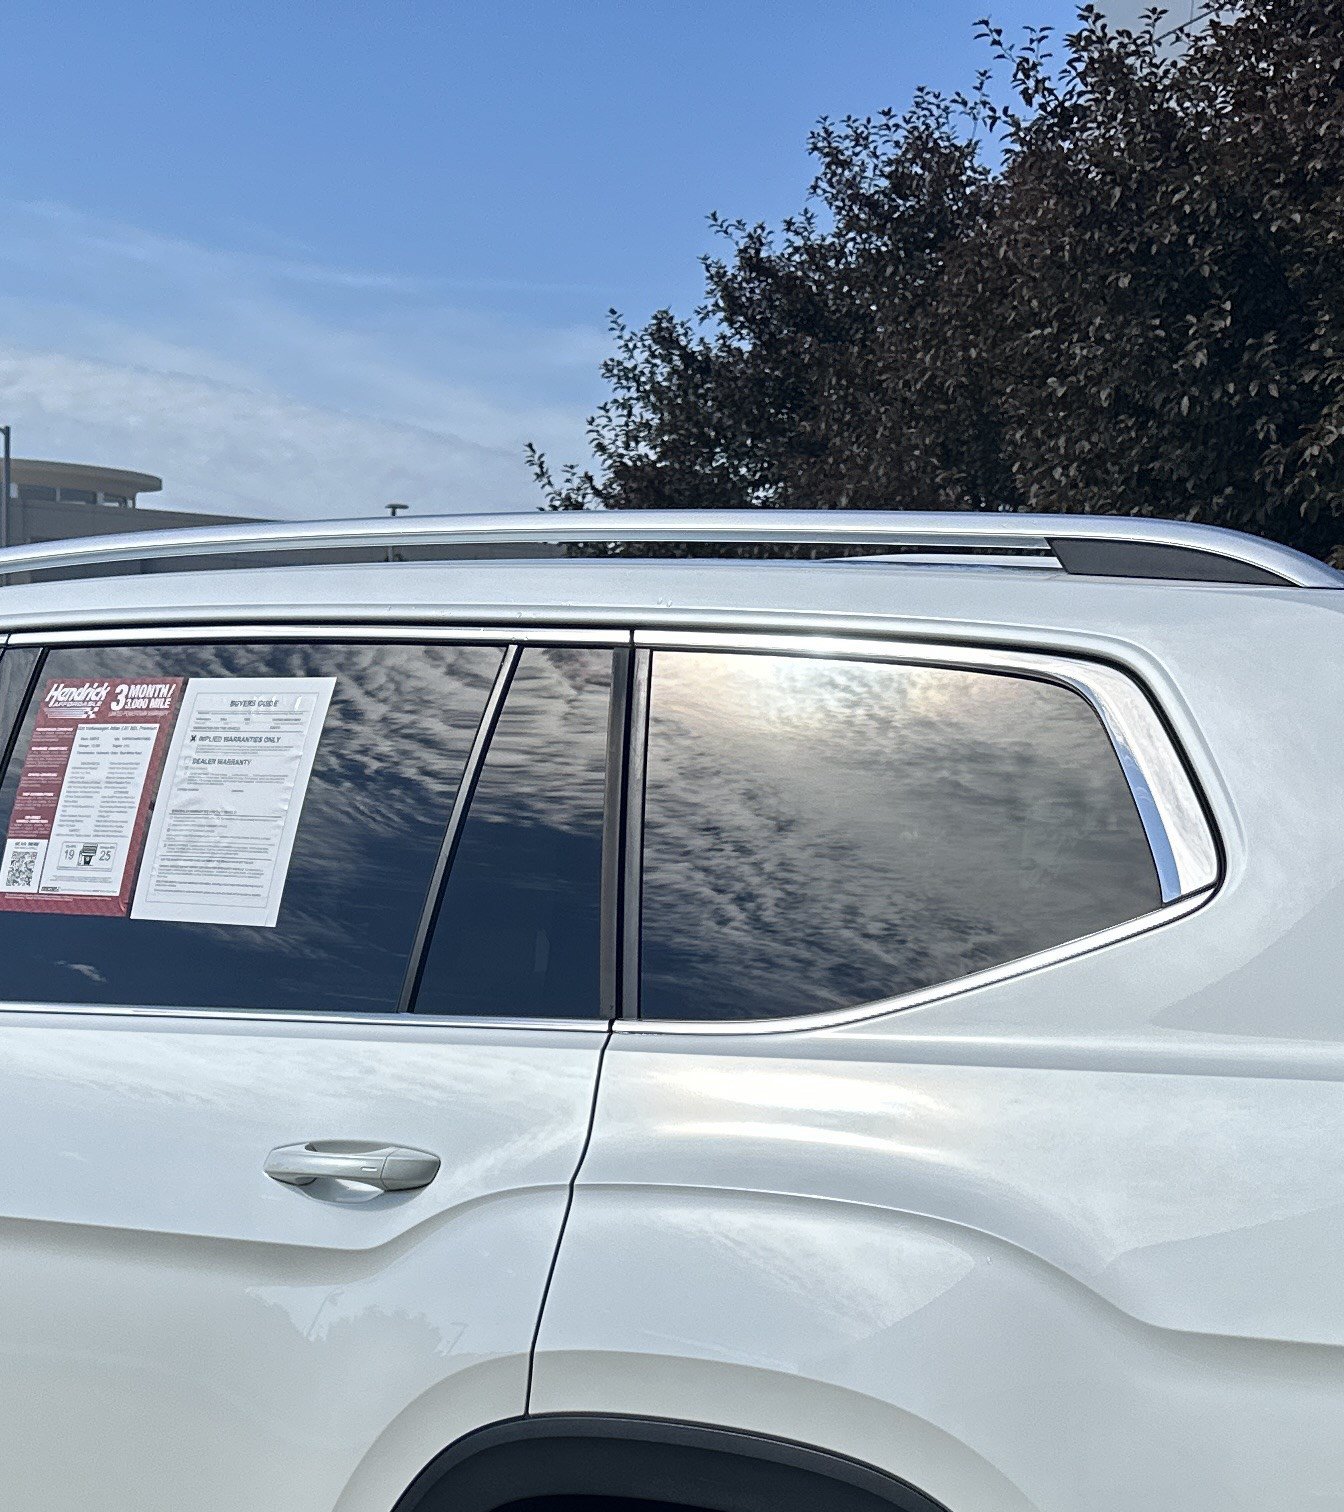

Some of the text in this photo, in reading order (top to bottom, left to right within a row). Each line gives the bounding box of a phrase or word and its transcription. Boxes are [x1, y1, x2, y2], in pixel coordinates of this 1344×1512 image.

[45, 683, 110, 707] Hendrick
[111, 684, 129, 710] 3
[149, 698, 172, 708] MILE
[198, 735, 222, 743] IMPLIED
[217, 758, 252, 766] WARRANTY
[64, 850, 75, 860] 19
[99, 850, 111, 861] 25
